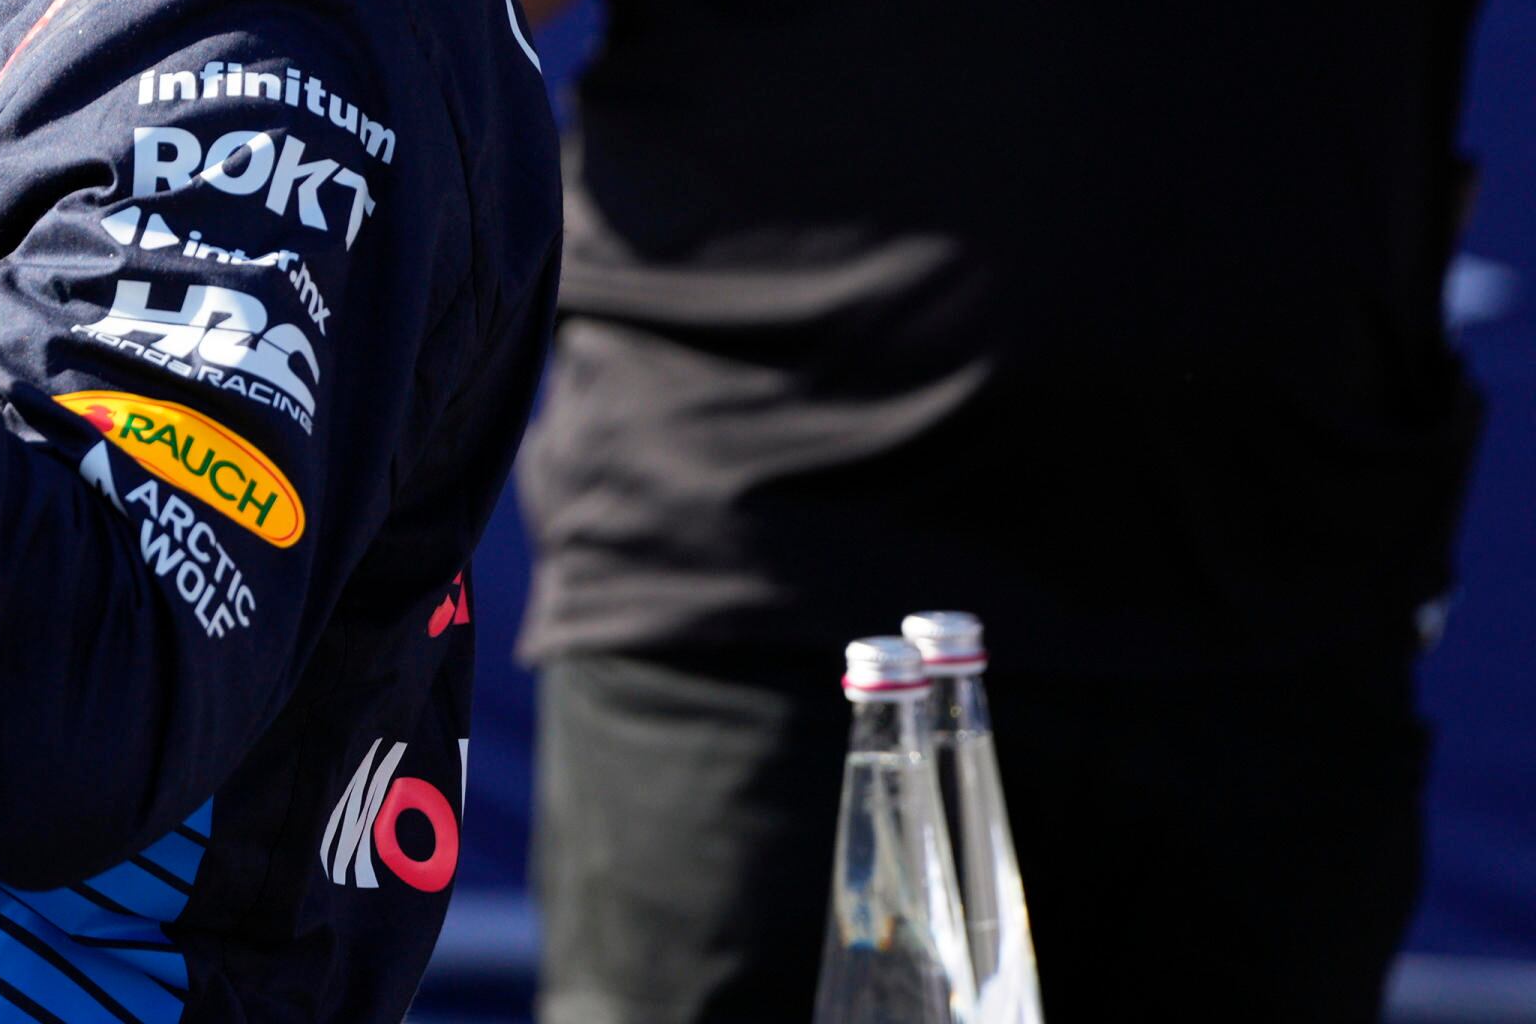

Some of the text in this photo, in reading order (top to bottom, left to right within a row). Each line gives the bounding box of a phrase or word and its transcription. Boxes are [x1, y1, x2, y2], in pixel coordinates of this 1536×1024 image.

[137, 61, 396, 165] infinitum
[132, 127, 376, 252] ROKT
[84, 279, 321, 417] HRC
[196, 364, 313, 437] RACING
[119, 413, 278, 528] RAUCH
[125, 479, 256, 628] ARCTIC
[140, 518, 236, 639] WOLF
[319, 737, 469, 893] Mo
